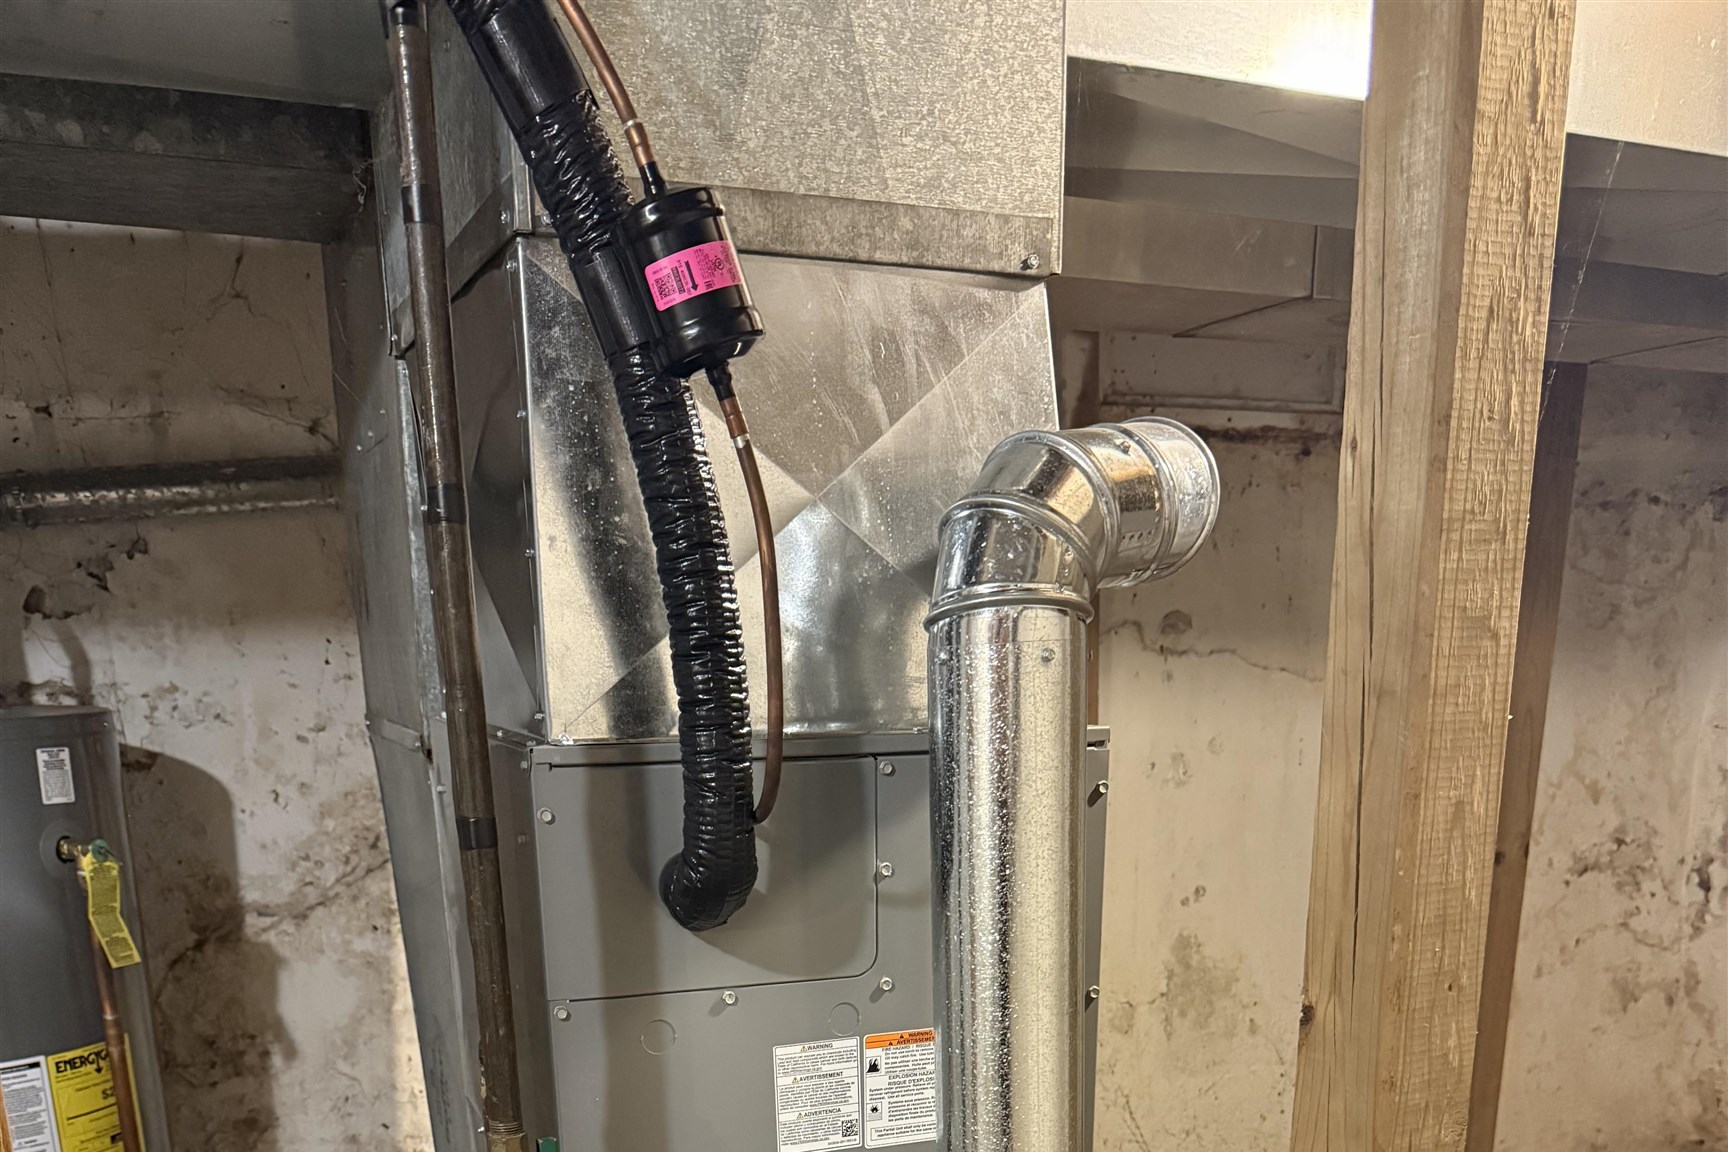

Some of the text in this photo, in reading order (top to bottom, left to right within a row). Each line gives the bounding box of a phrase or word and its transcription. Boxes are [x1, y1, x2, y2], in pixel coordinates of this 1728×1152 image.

[55, 1048, 109, 1073] ENERGYG
[799, 1071, 843, 1081] AVERTISSEMENT
[888, 1072, 917, 1080] EXPLOSION
[804, 1108, 841, 1117] ADVERTENCIA
